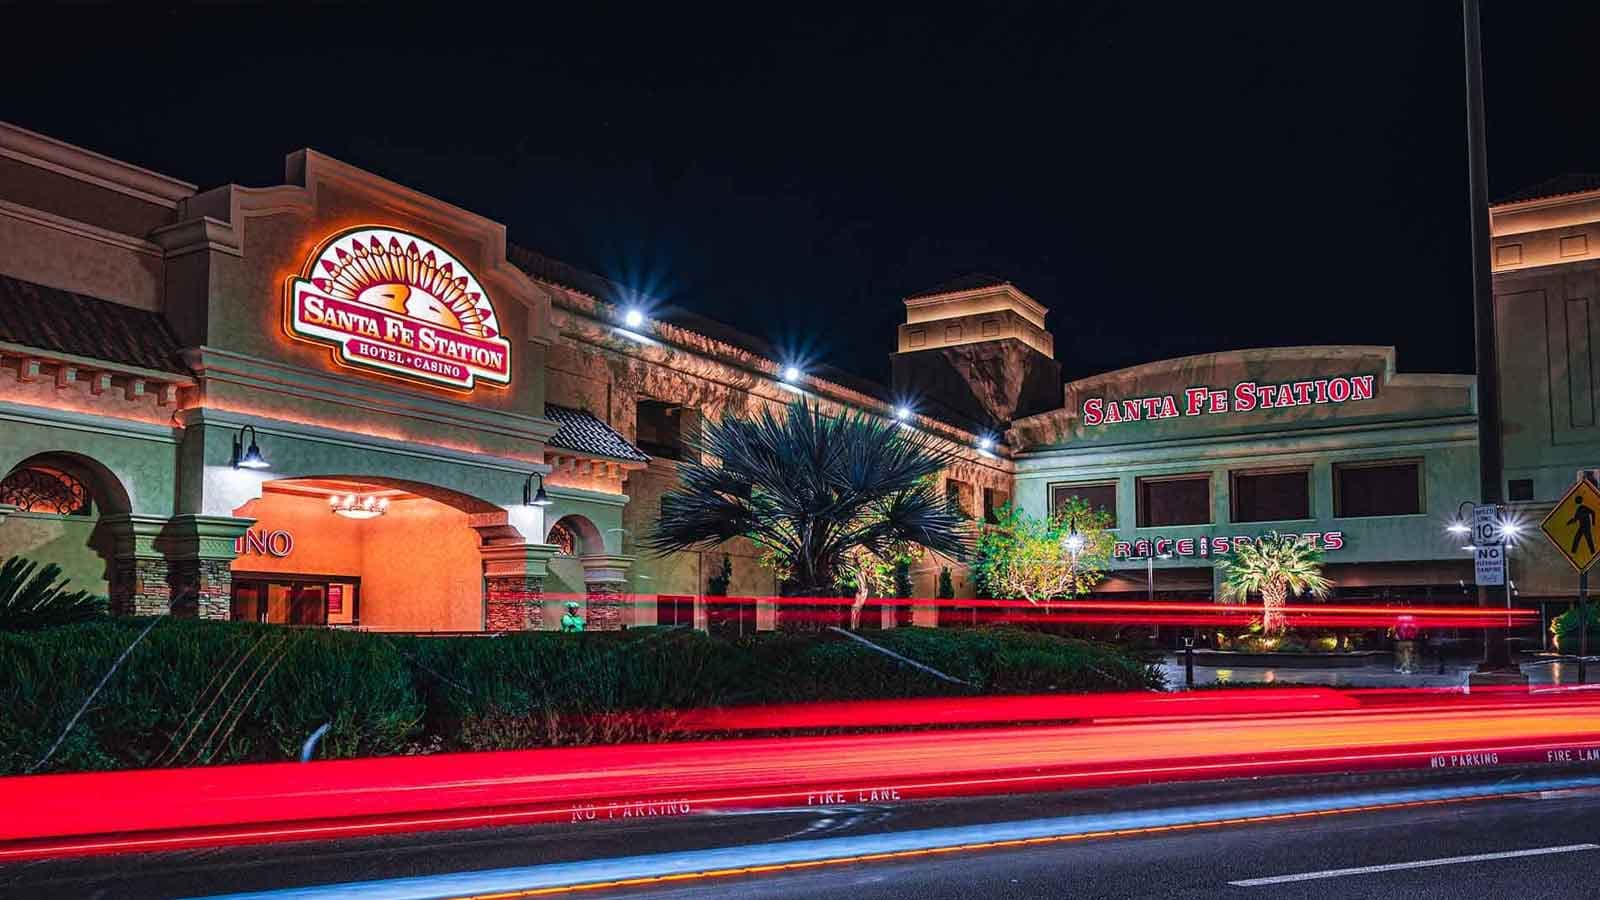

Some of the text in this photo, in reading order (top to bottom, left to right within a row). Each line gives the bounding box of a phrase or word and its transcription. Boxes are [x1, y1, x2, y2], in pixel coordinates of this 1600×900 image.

[304, 297, 503, 369] SANTA FE STATION
[359, 343, 461, 377] HOTEL CASINO
[1084, 375, 1375, 426] SANTA FE STATION
[1477, 523, 1494, 538] 10
[1113, 538, 1194, 558] RACE
[1211, 531, 1344, 554] SPRTS
[1478, 549, 1499, 559] NO
[1430, 752, 1499, 768] NO PARKING
[1547, 750, 1572, 762] FIRE
[807, 787, 901, 806] FIRE LANE
[571, 798, 691, 823] NO PARKING
